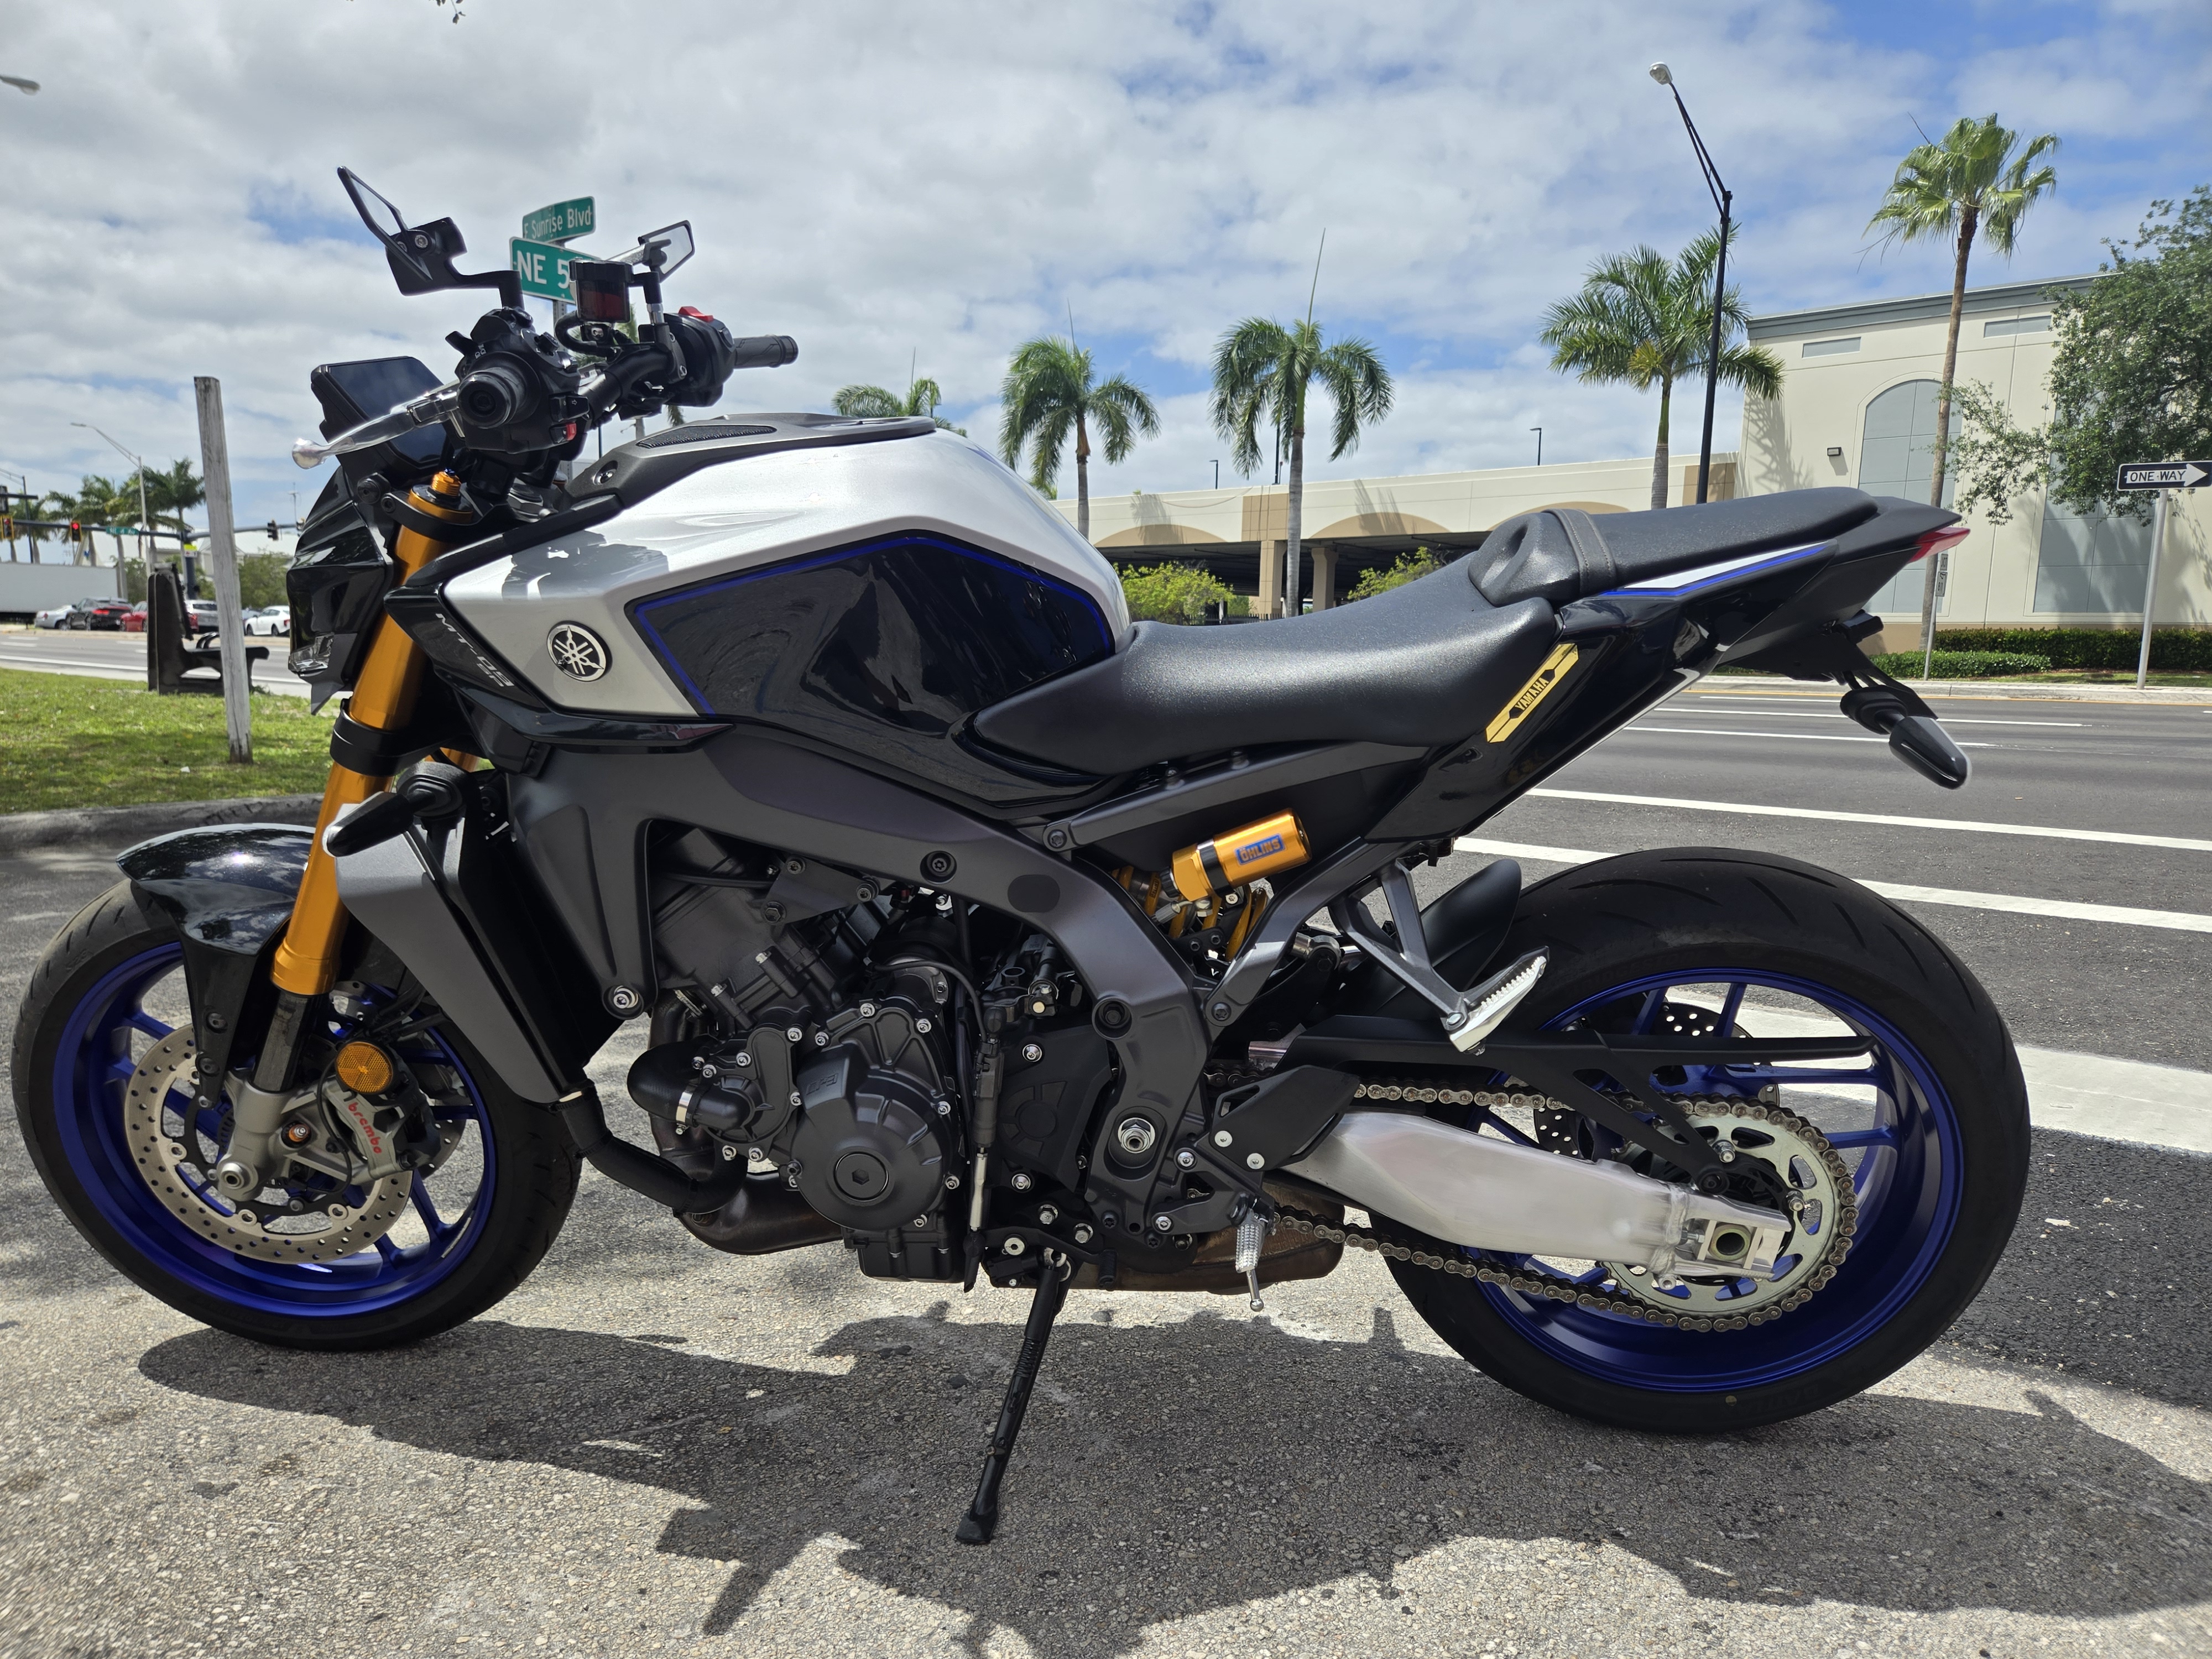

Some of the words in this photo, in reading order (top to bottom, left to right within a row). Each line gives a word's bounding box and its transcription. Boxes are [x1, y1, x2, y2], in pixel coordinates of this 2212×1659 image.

[531, 215, 563, 239] Sunrise
[567, 206, 592, 228] Blvd
[517, 250, 547, 284] NE
[2130, 472, 2154, 482] ONE
[2160, 470, 2186, 481] WAY
[435, 613, 515, 686] MT-09
[476, 663, 504, 687] SP
[1515, 677, 1550, 711] YAMAHA
[1239, 837, 1281, 862] ÖHLINS
[347, 1102, 382, 1154] brembo
